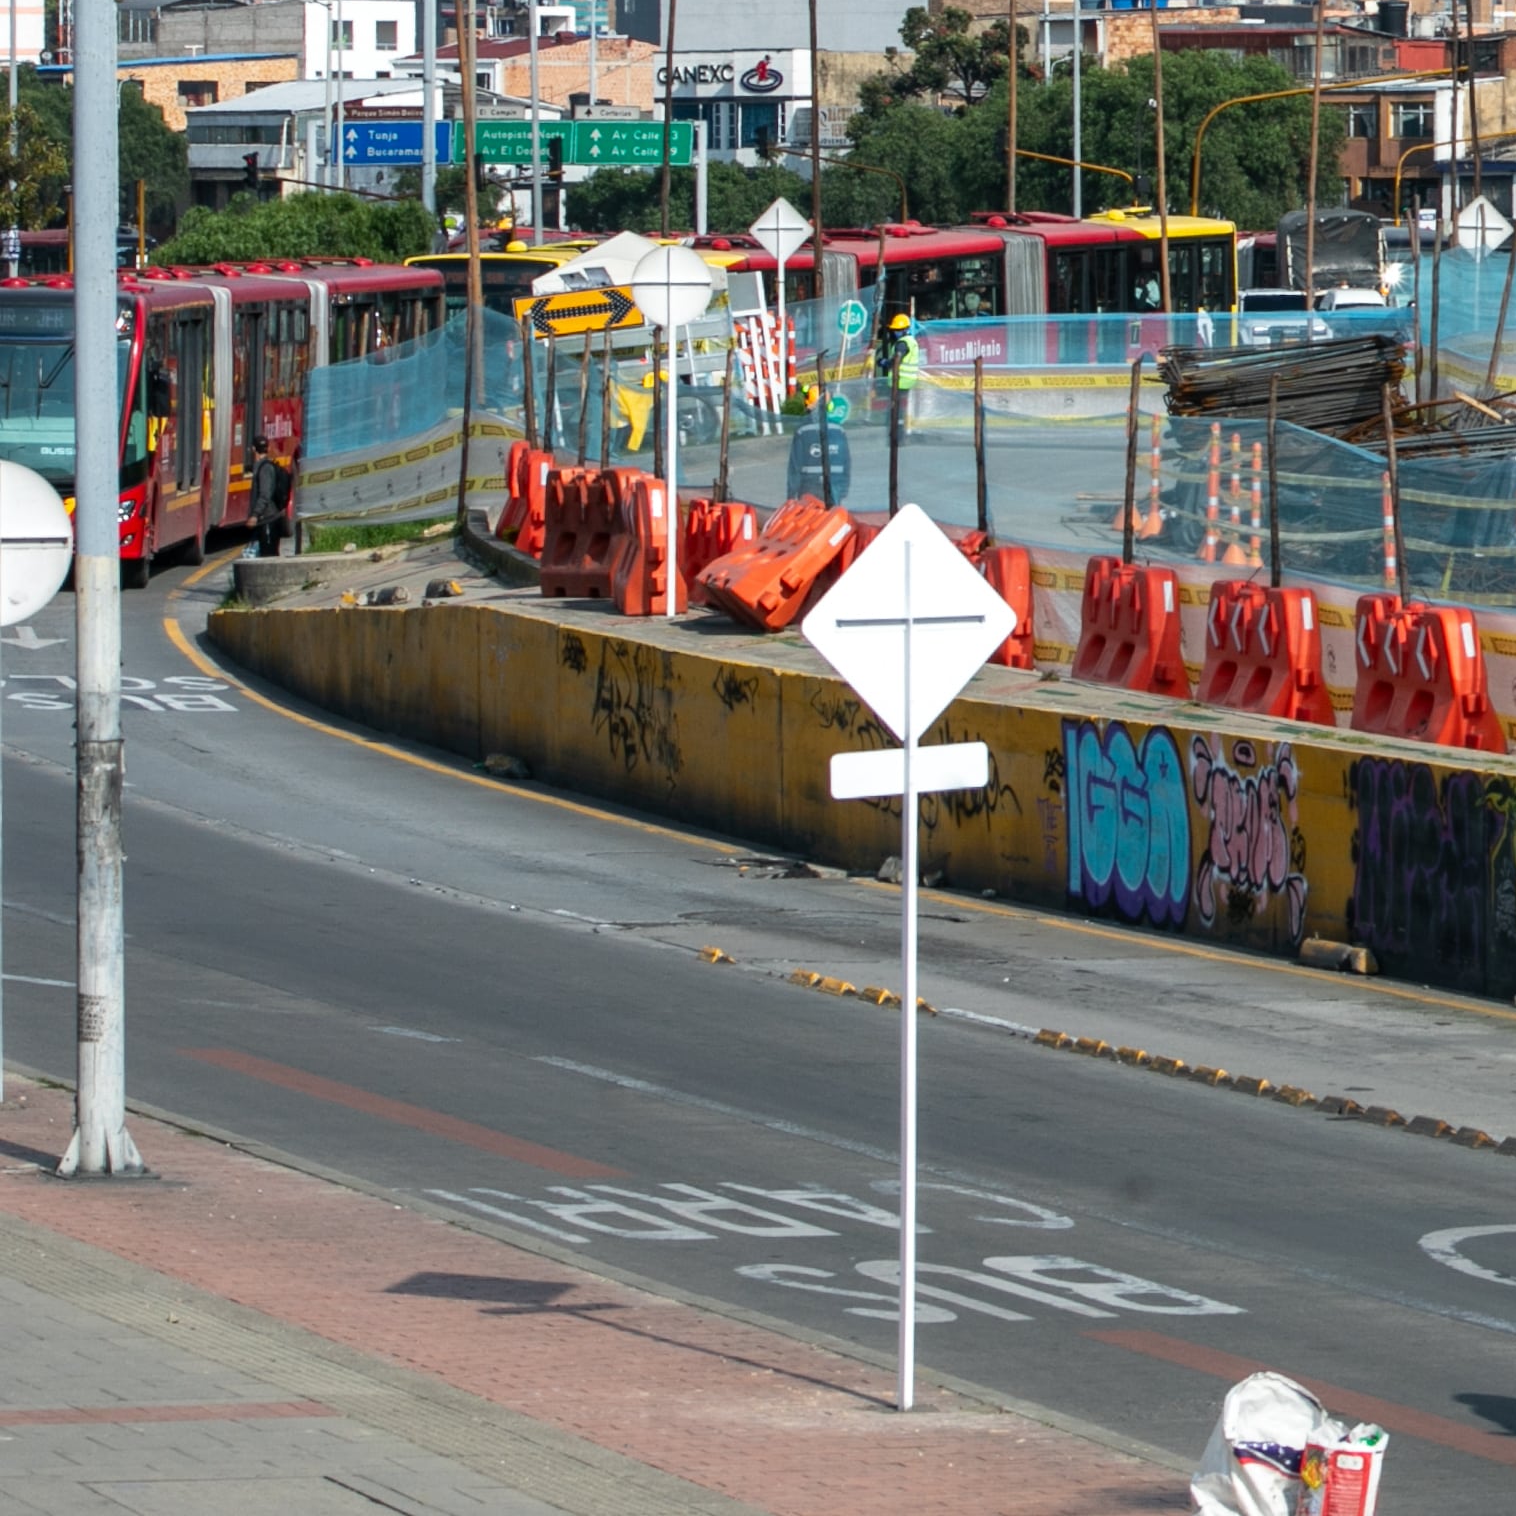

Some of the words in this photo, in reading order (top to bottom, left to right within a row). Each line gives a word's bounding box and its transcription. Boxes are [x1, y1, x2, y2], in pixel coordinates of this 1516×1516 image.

[367, 129, 398, 142] Tunja
[611, 130, 627, 141] Av
[633, 129, 660, 141] Calle
[482, 146, 496, 156] Av
[501, 146, 512, 156] El
[611, 146, 626, 156] Av
[633, 146, 660, 157] Calle
[940, 339, 1002, 364] TransMilenio
[40, 446, 76, 455] BUSS
[733, 1254, 1248, 1324] BUS
